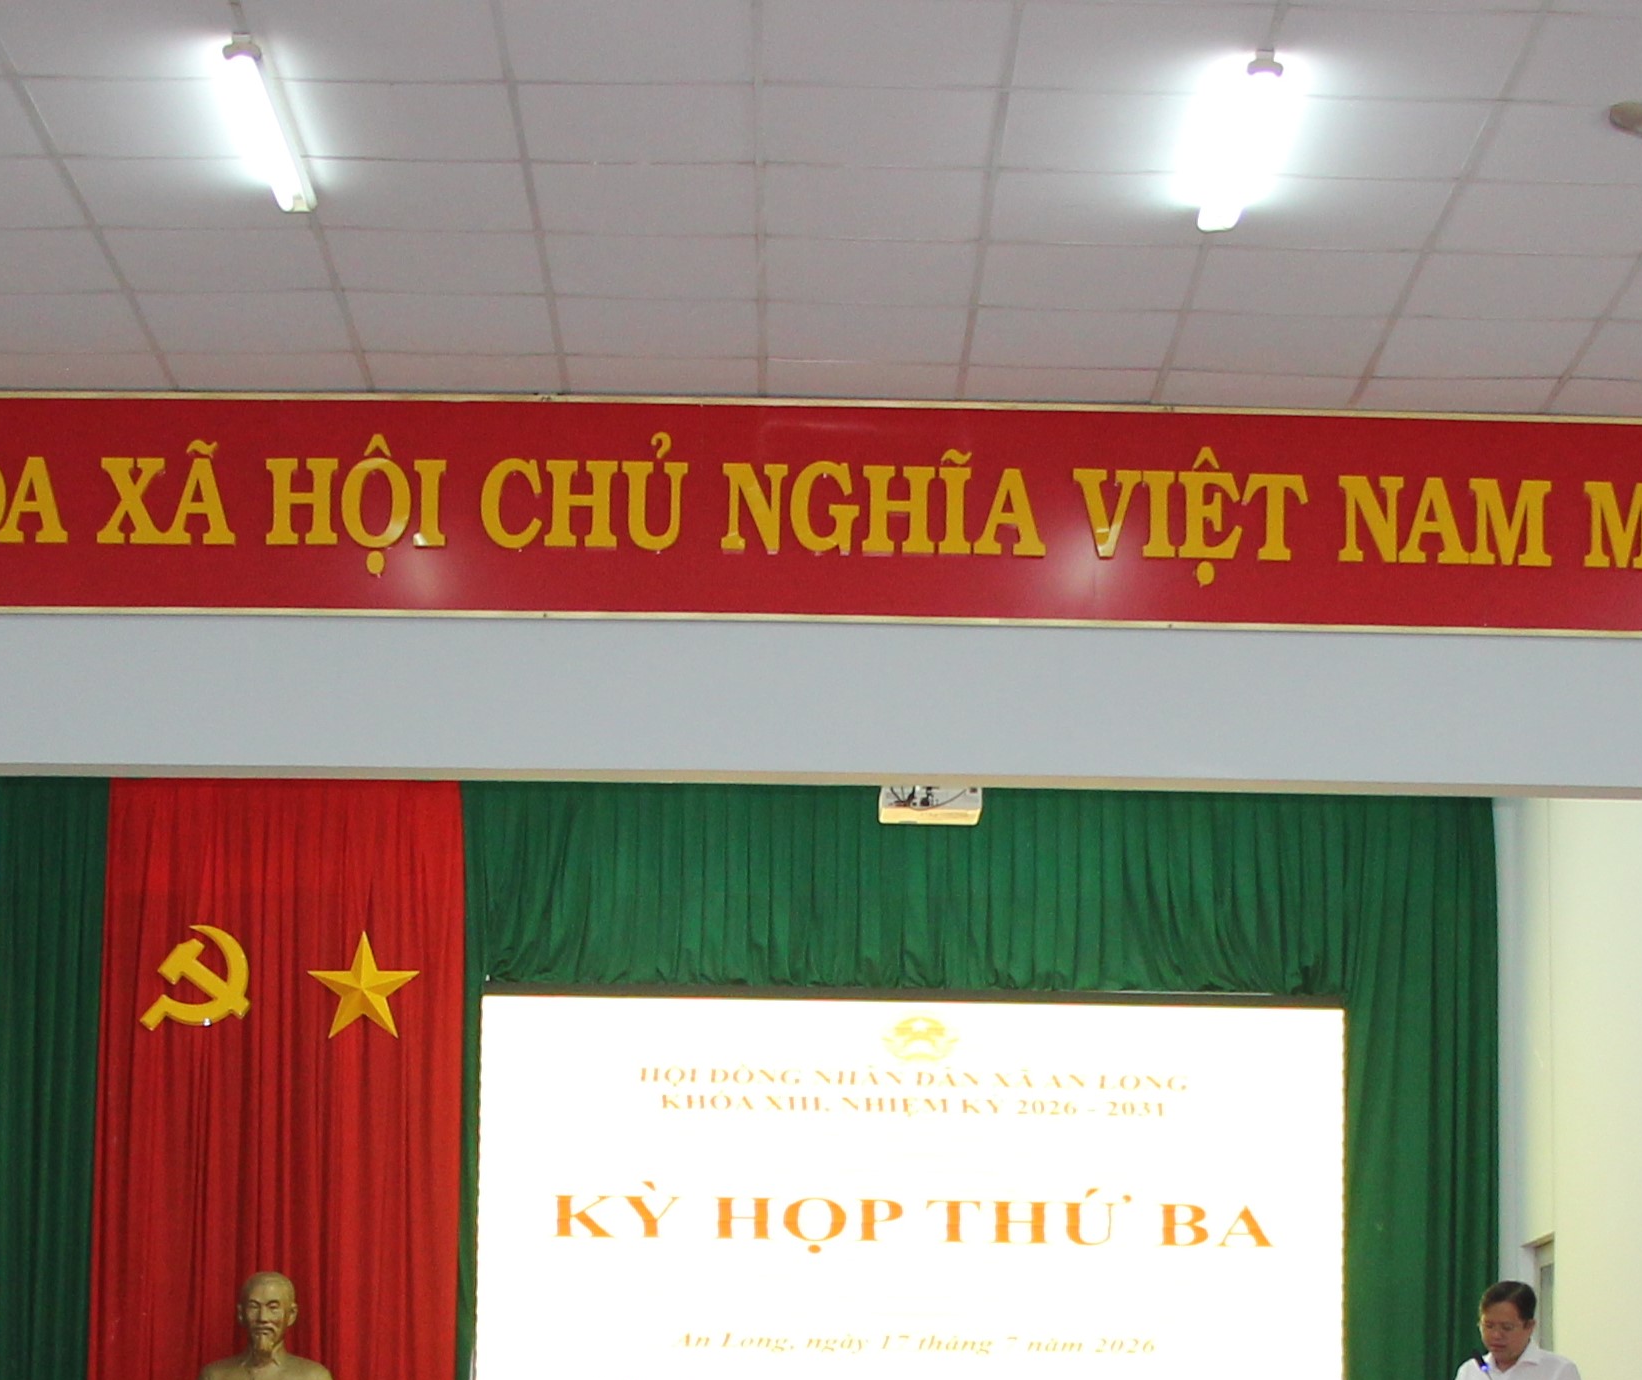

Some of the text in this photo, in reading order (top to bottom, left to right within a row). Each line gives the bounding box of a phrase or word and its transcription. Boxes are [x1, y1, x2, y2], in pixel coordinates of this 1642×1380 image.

[97, 441, 236, 546] XÃ
[265, 433, 447, 577] HỘI
[479, 432, 688, 551] CHỦ
[720, 448, 1046, 559] NGHĨA
[1072, 446, 1308, 586] VIỆT
[1338, 475, 1552, 567] NAM
[661, 1090, 754, 1110] KHÓA
[842, 1097, 949, 1117] NHIỆM
[1017, 1100, 1078, 1116] 2026
[1106, 1102, 1166, 1117] 2031
[554, 1181, 1273, 1254] KỲ HỌP THỨ BA
